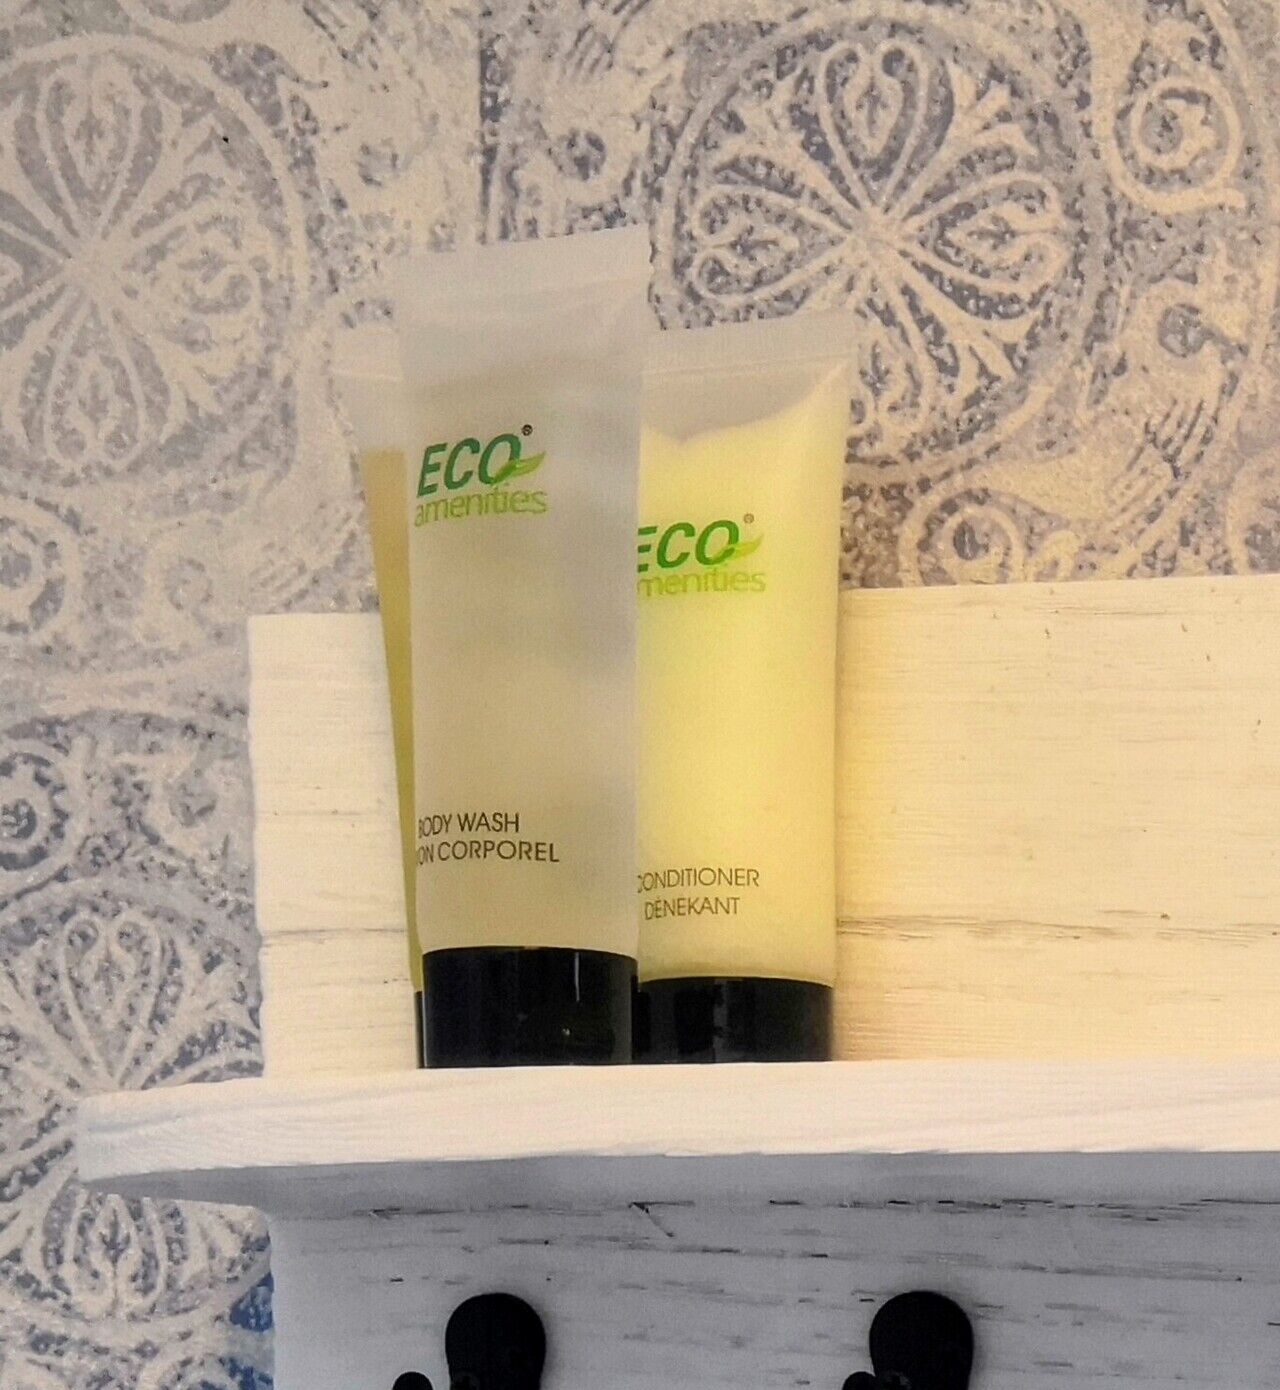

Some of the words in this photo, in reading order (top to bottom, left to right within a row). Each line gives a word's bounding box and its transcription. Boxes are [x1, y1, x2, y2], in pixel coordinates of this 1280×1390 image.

[417, 433, 522, 498] ECO
[414, 483, 549, 528] amenities
[637, 568, 766, 597] menities
[457, 812, 520, 833] WASH
[438, 840, 560, 863] CORPOREL
